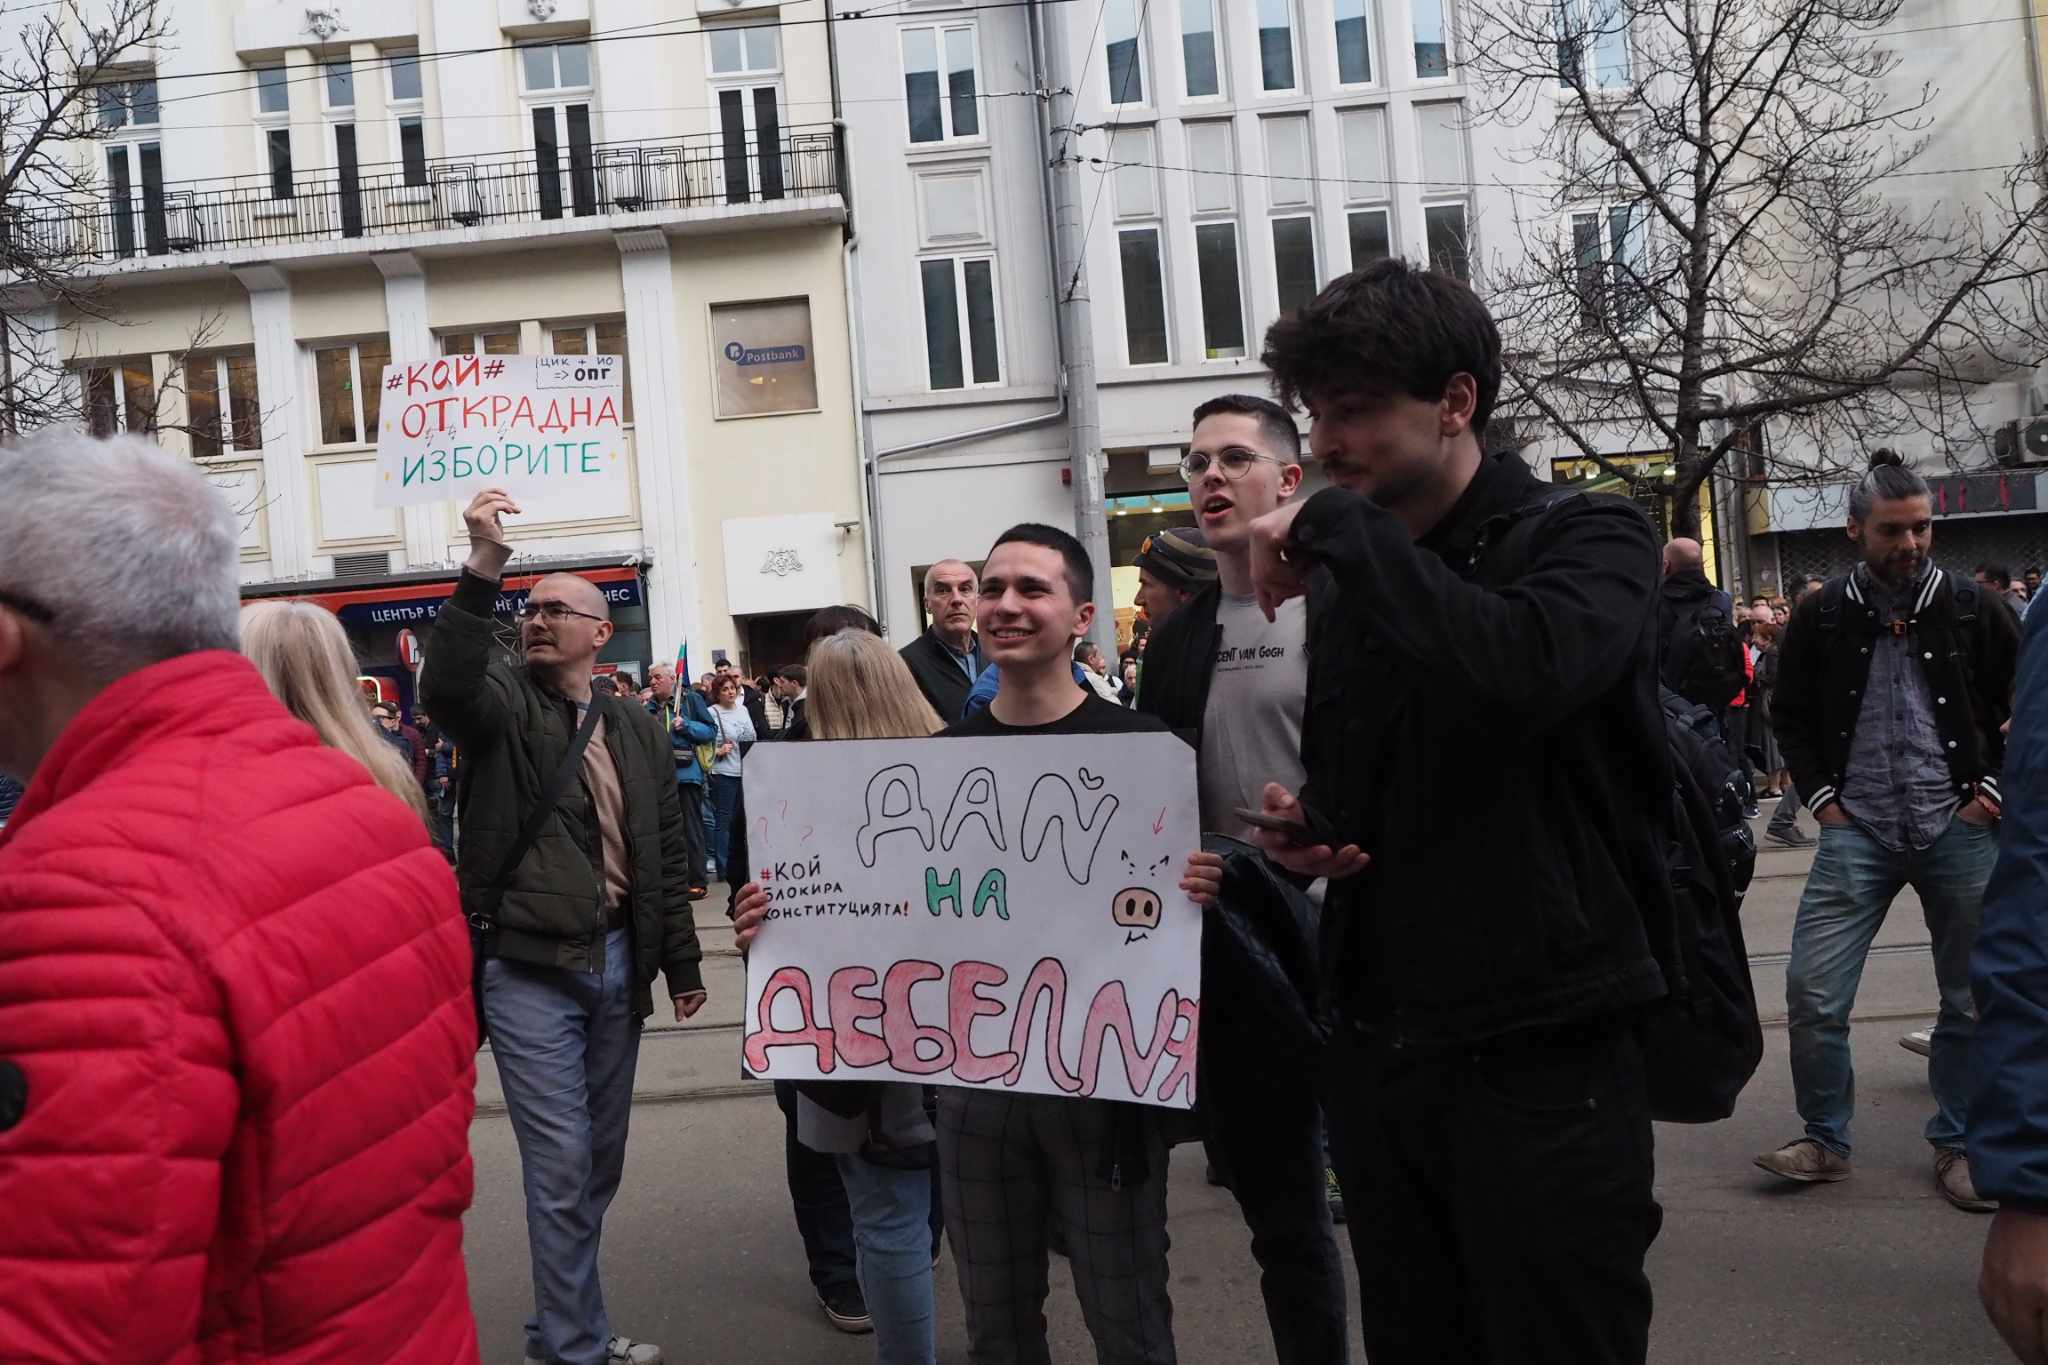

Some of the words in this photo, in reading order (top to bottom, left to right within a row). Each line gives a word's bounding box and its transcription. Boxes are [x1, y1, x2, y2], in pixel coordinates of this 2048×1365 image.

[540, 357, 571, 368] ЦИК
[597, 356, 614, 366] ИО
[746, 349, 800, 362] Postbank
[574, 367, 612, 381] ОПГ
[402, 395, 620, 439] ОТКРАДНА
[402, 441, 602, 487] ИЗБОРИТЕ
[371, 607, 424, 624] ЦЕНТЪР
[1239, 647, 1256, 660] VAN
[855, 763, 1120, 885] ДАЙ
[760, 854, 822, 882] #КОЙ
[924, 866, 1011, 920] НА
[743, 956, 1201, 1105] ДЕБЕЛИЯ
